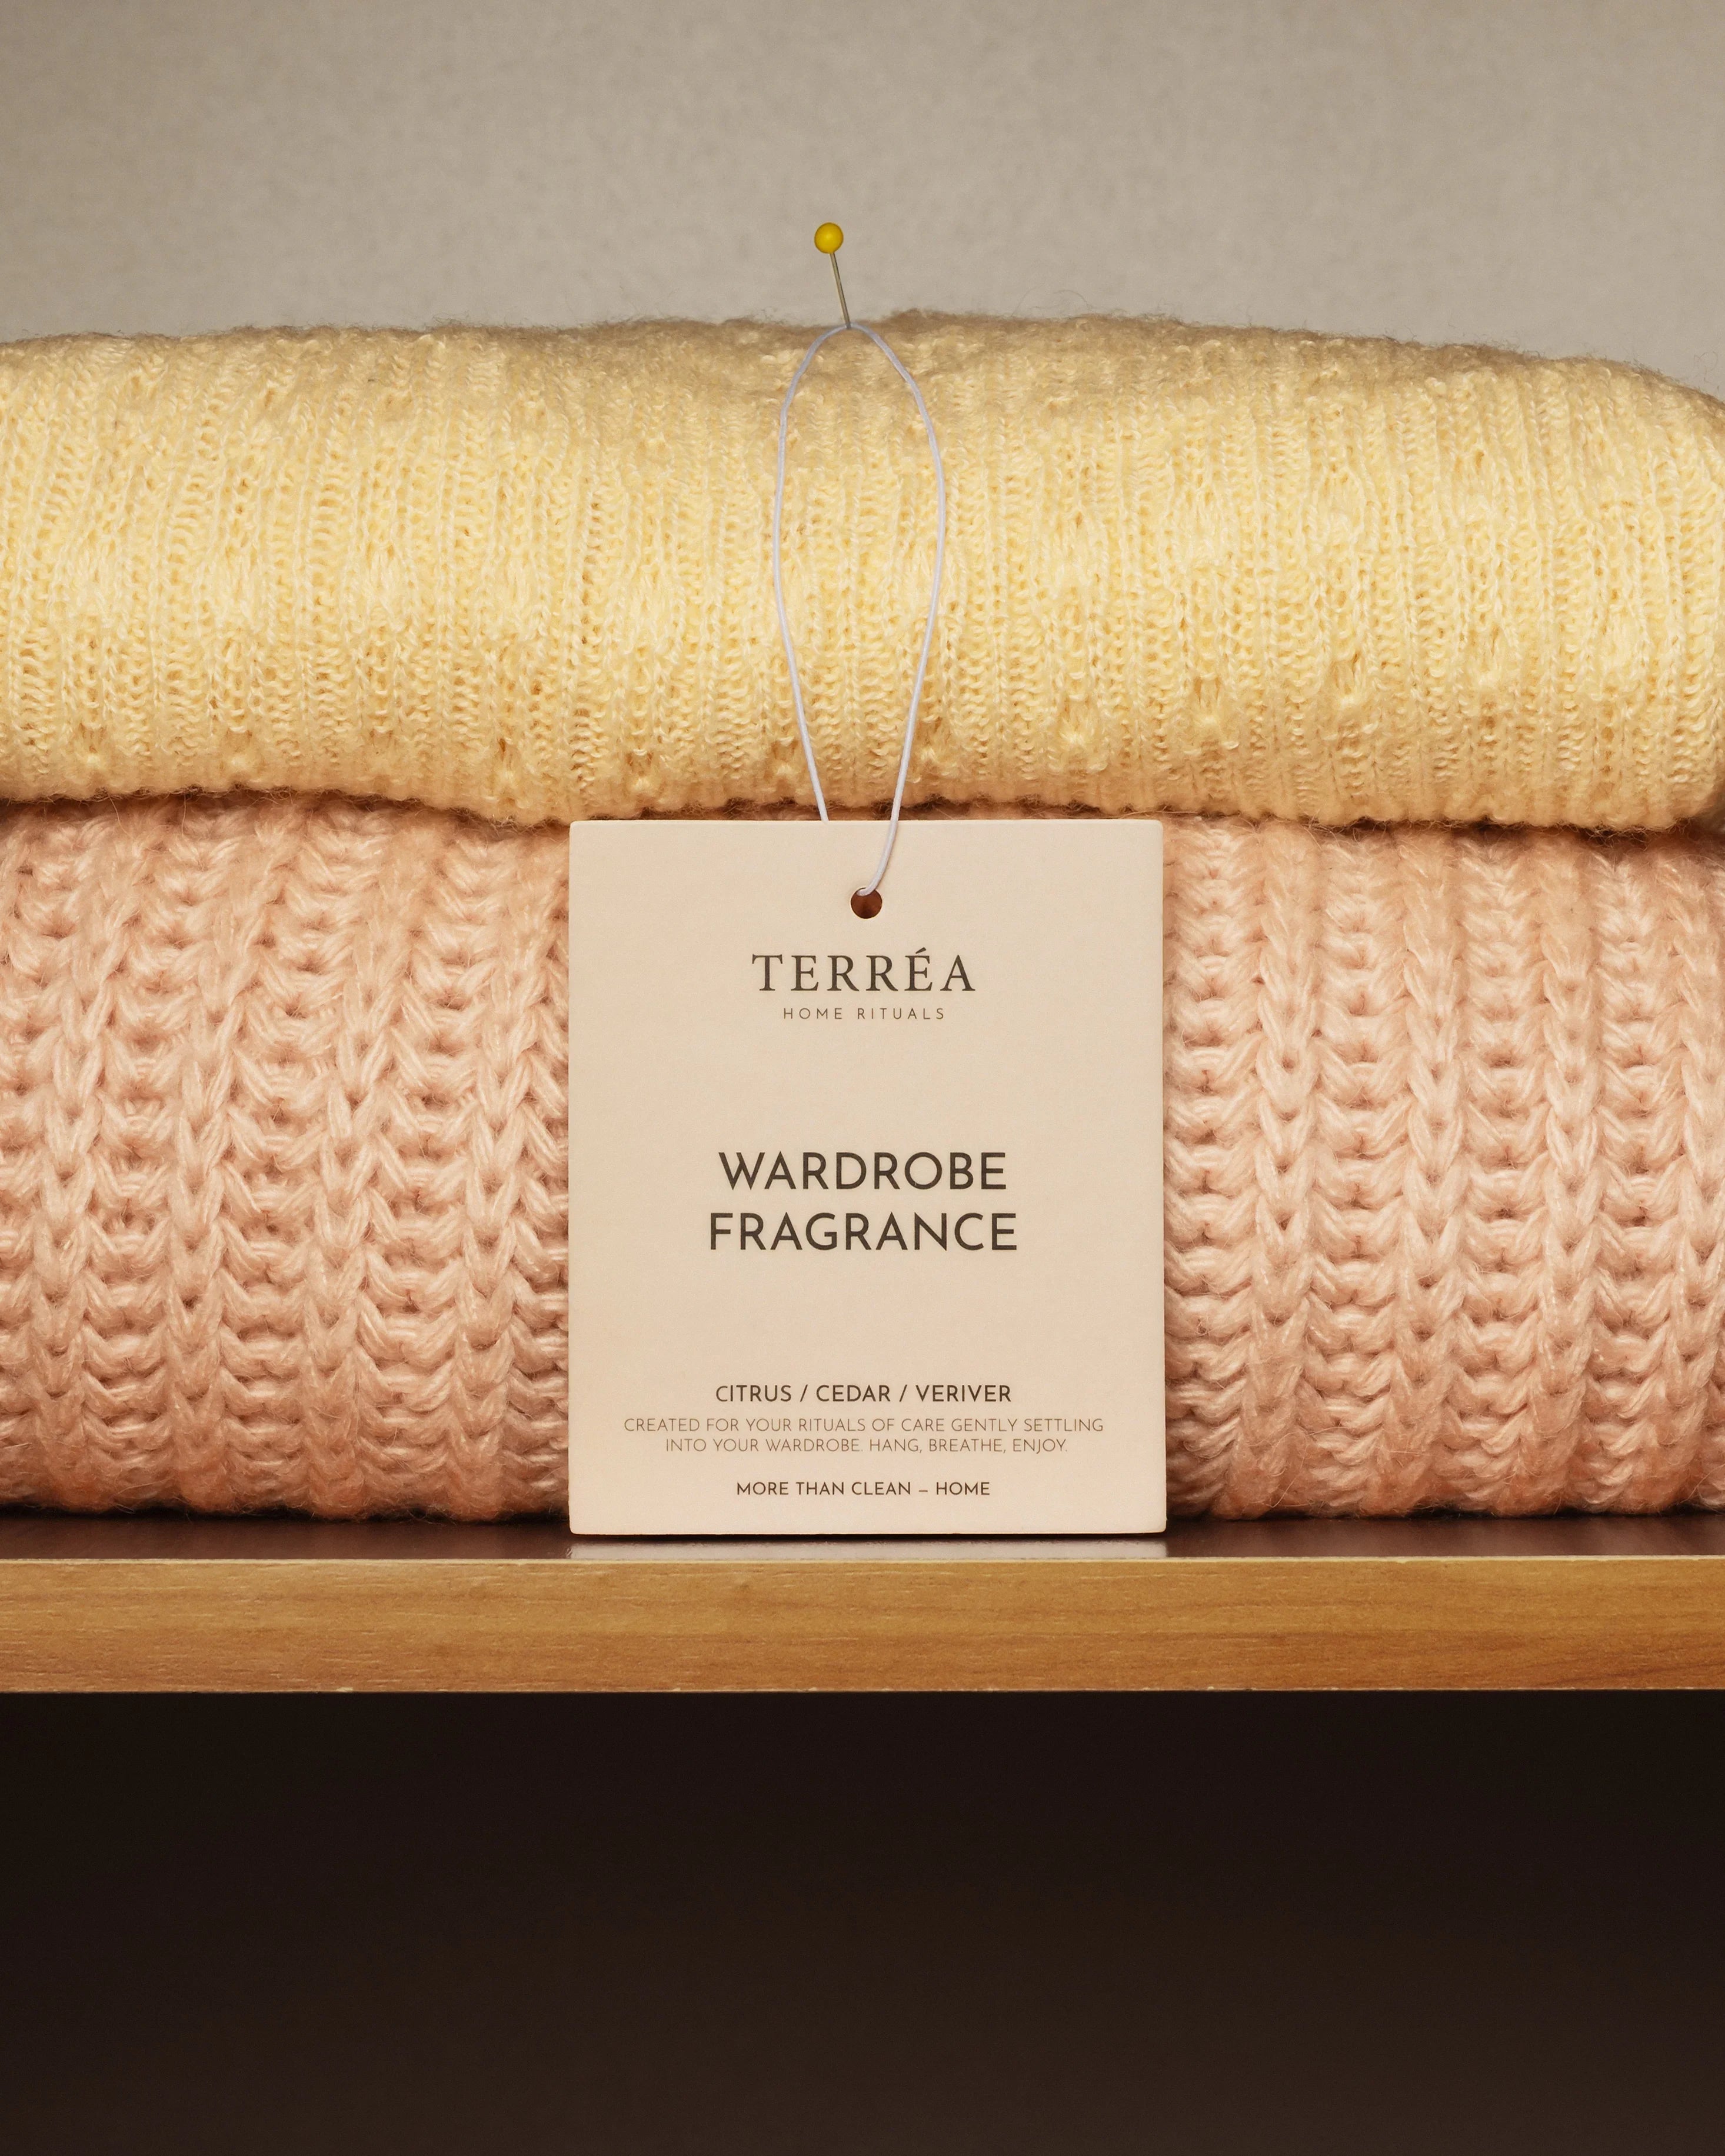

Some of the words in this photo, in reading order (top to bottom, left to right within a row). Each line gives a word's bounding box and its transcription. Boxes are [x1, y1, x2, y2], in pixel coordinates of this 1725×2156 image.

[752, 947, 976, 992] TERRÉA
[783, 1007, 843, 1020] HOME
[857, 1007, 944, 1020] RITUALS
[718, 1150, 1007, 1191] WARDROBE
[710, 1211, 1017, 1252] FRAGRANCE
[715, 1384, 792, 1402] CITRUS
[799, 1384, 808, 1403] /
[815, 1384, 891, 1402] CEDAR
[898, 1384, 908, 1403] /
[915, 1384, 1012, 1402] VERIVER
[624, 1418, 700, 1432] CREATED
[707, 1418, 740, 1432] FOR
[745, 1418, 792, 1432] YOUR
[798, 1418, 866, 1432] RITUALS
[871, 1418, 895, 1432] OF
[901, 1418, 945, 1432] CARE
[951, 1418, 1018, 1432] GENTLY
[1024, 1418, 1104, 1432] SETTLING
[666, 1438, 707, 1452] INTO
[712, 1438, 759, 1452] YOUR
[765, 1438, 864, 1452] WARDROBE.
[870, 1438, 923, 1454] HANG,
[929, 1438, 1006, 1454] BREATHE,
[1013, 1438, 1068, 1455] ENJOY.
[737, 1481, 790, 1496] MORE
[795, 1481, 844, 1496] THAN
[851, 1481, 911, 1496] CLEAN
[936, 1481, 990, 1496] HOME
